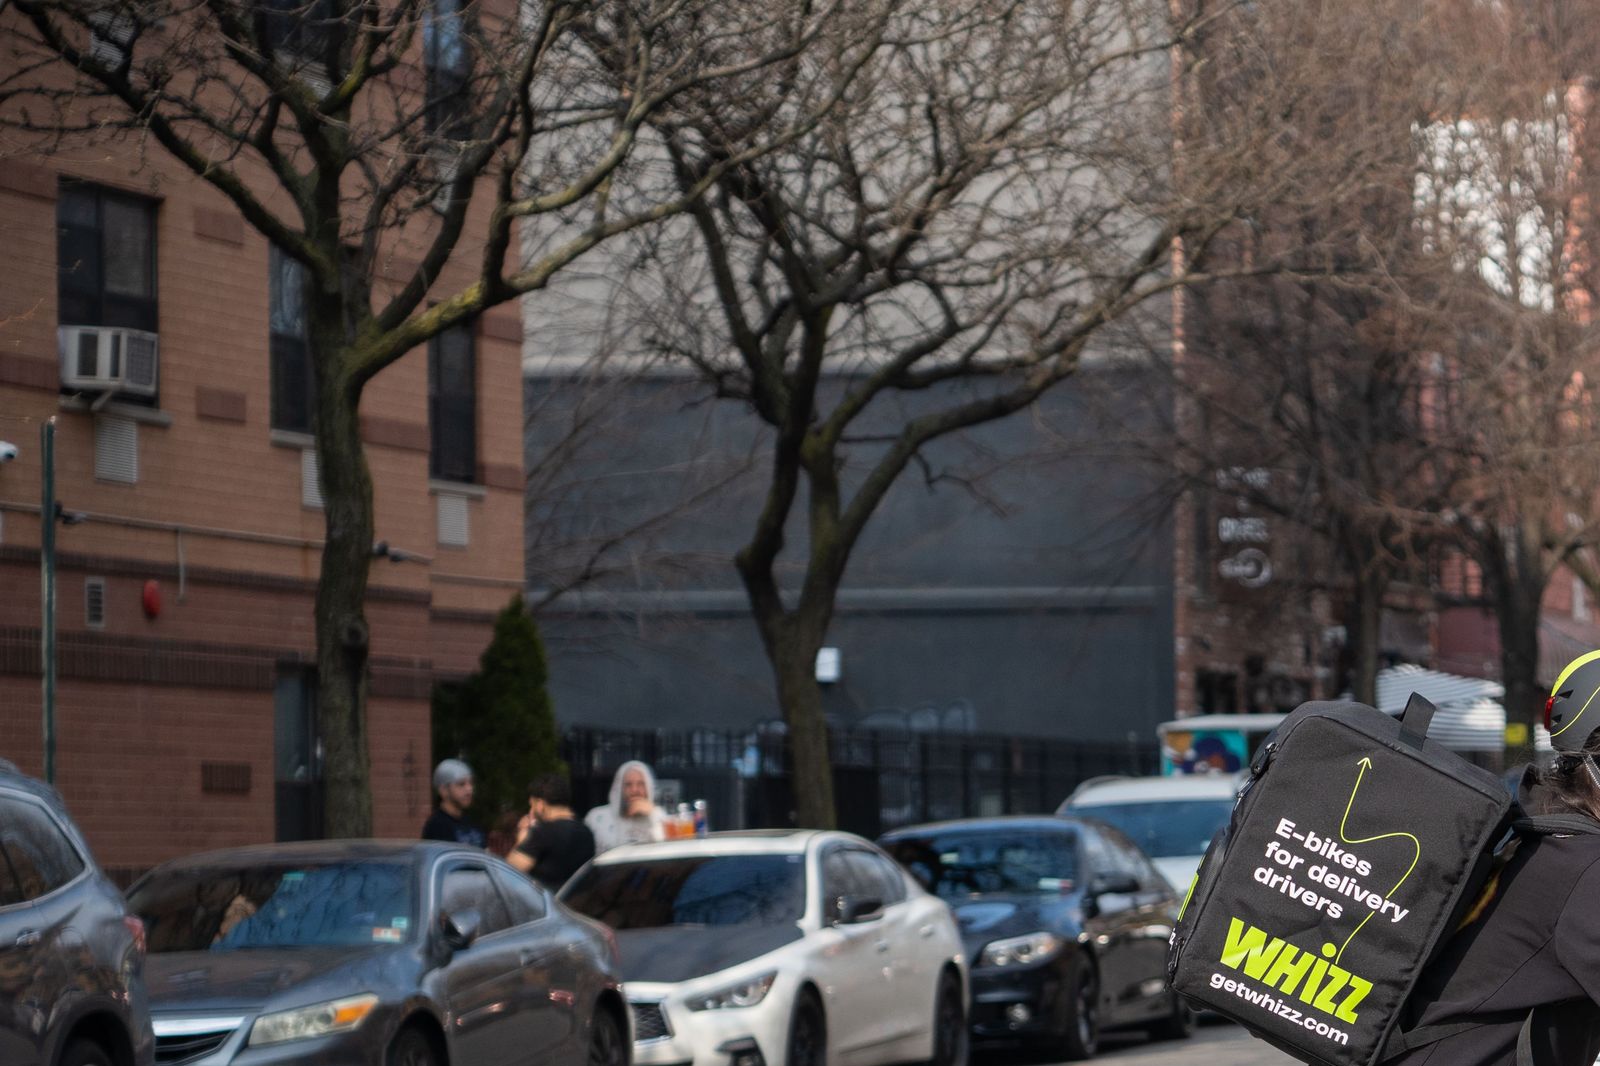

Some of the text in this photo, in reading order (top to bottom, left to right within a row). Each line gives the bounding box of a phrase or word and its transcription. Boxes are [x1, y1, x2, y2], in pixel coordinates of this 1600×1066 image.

[1275, 818, 1373, 877] E-bikes
[1253, 866, 1343, 920] drivers
[1265, 841, 1410, 923] for delivery
[1209, 972, 1349, 1046] getwhizz.com
